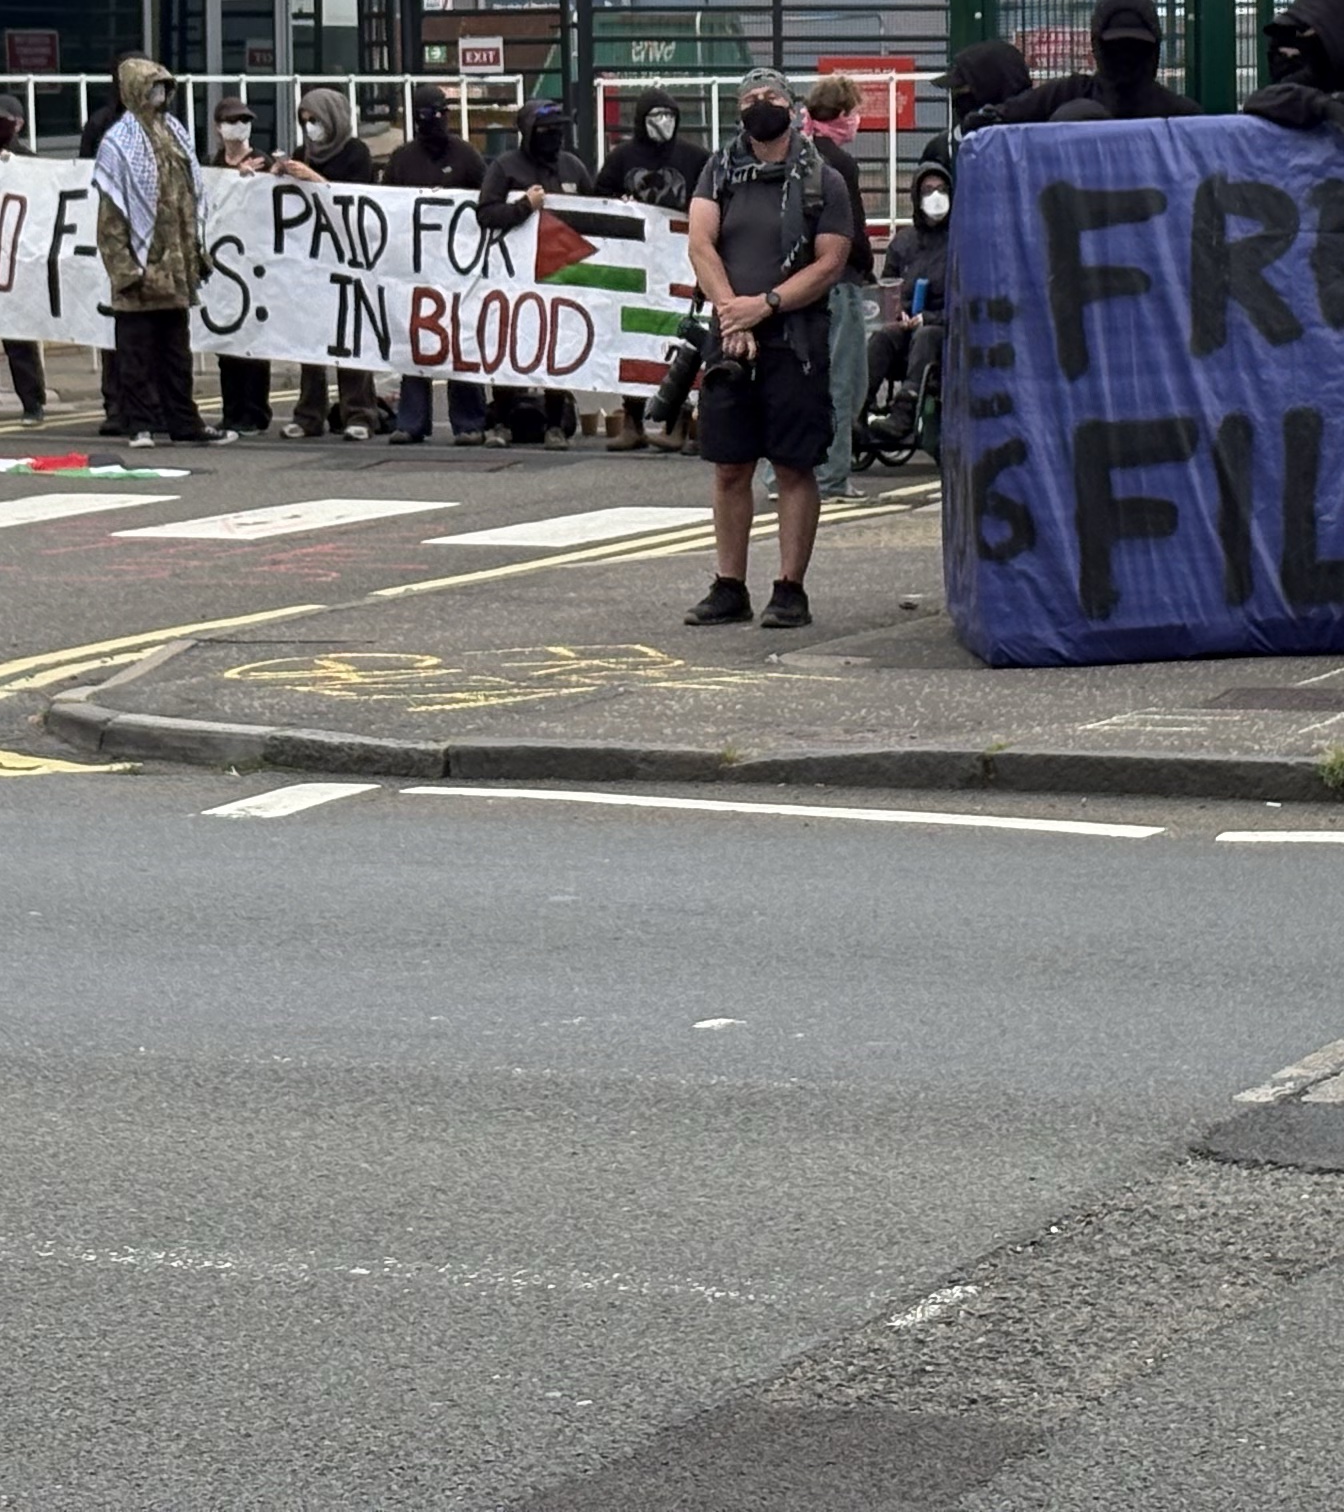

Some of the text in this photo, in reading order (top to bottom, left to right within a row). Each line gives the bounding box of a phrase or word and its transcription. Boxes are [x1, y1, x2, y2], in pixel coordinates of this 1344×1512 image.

[464, 50, 496, 64] EXIT
[272, 184, 388, 270] PAID
[327, 273, 595, 375] IN BLOOD
